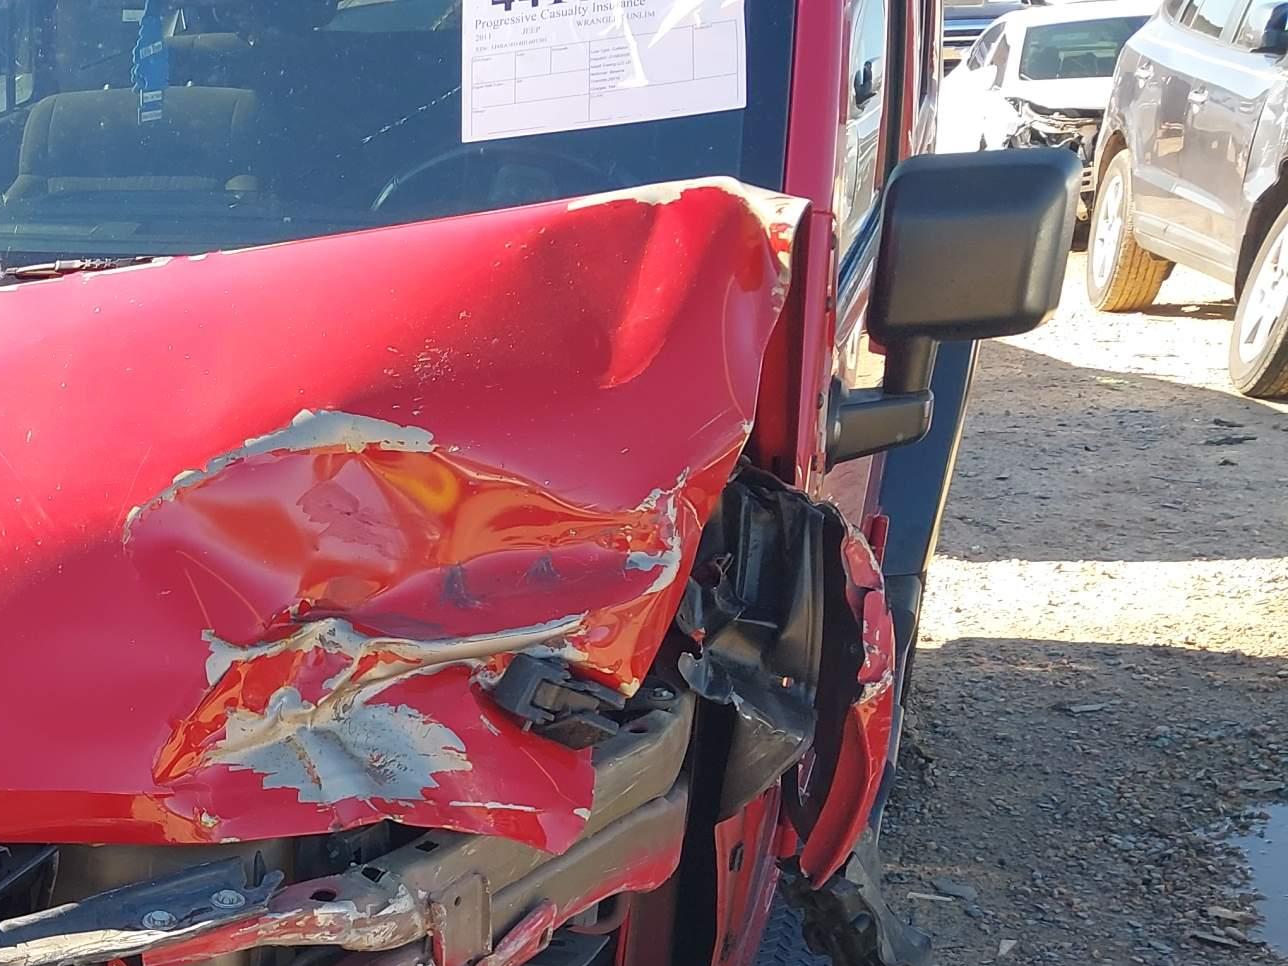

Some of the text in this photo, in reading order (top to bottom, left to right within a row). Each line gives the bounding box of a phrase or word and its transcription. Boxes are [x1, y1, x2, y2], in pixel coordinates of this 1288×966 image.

[475, 12, 537, 30] Progressive
[540, 5, 588, 20] Casualty
[592, 0, 646, 13] Insuance
